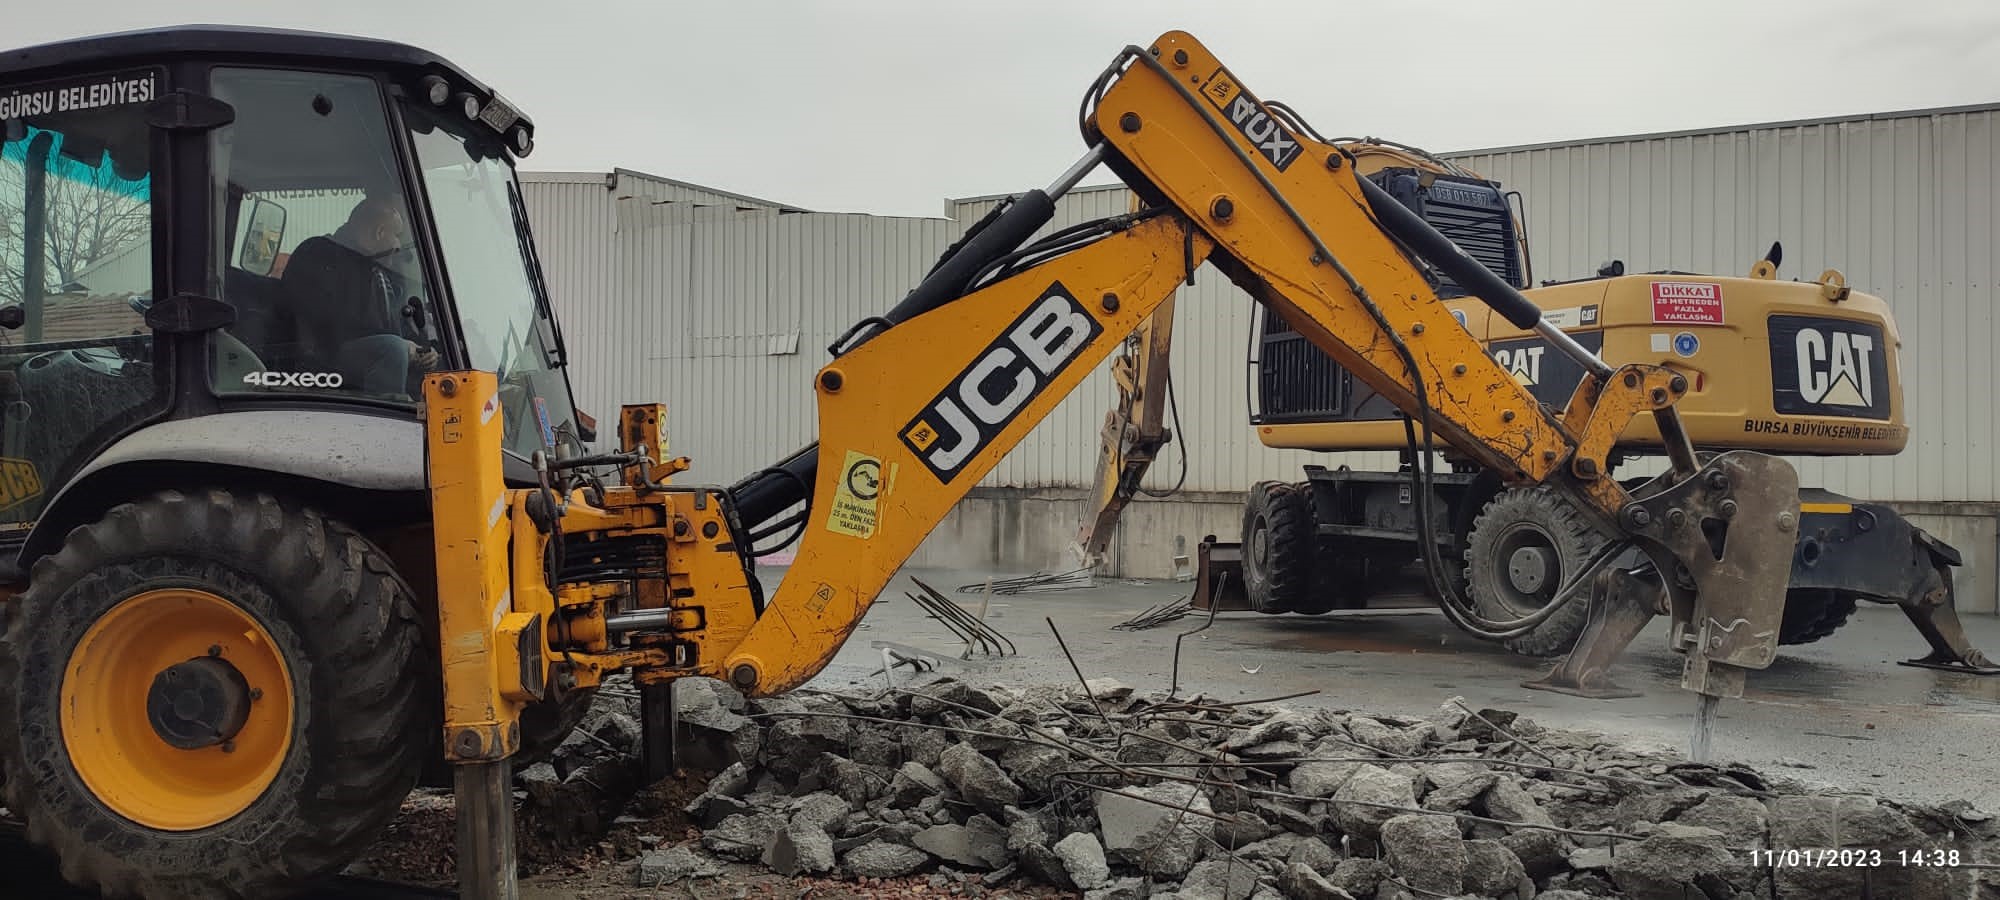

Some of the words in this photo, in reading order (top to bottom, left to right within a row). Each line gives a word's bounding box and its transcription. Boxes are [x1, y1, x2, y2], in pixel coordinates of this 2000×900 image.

[0, 90, 54, 120] GÜRSU
[58, 71, 155, 112] BELEDİYESİ
[1232, 95, 1296, 164] 4CX
[1581, 308, 1597, 321] CAT
[1662, 285, 1711, 297] DİKKAT
[928, 295, 1092, 471] JCB
[1795, 328, 1873, 408] CAT
[1744, 419, 1789, 434] BURSA
